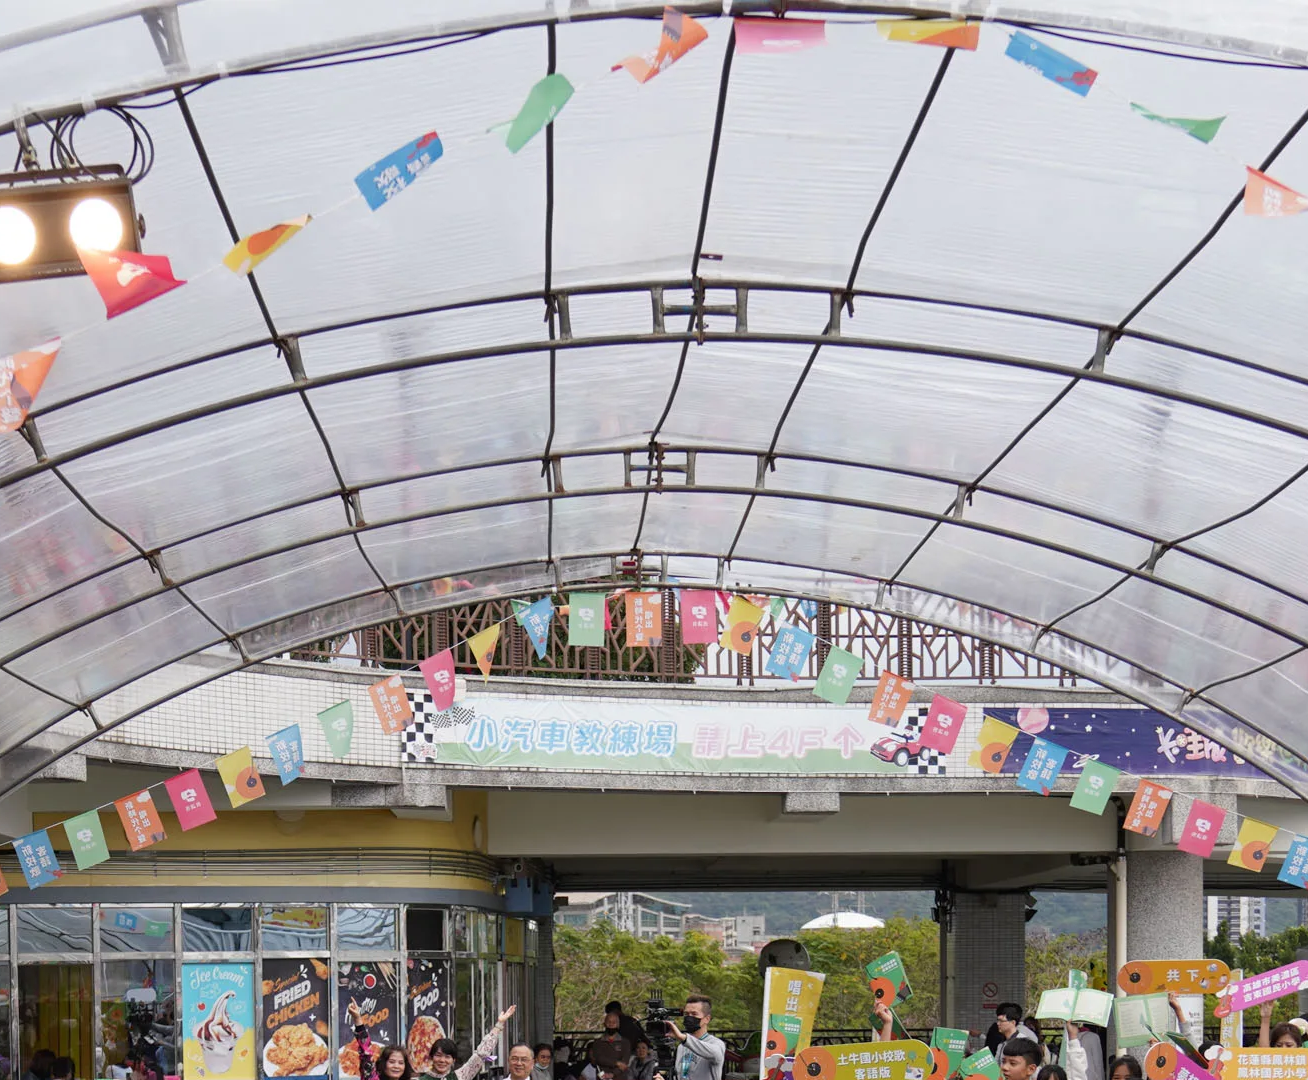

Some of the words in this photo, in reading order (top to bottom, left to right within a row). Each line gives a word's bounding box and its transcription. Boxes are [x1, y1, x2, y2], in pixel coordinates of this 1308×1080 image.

[466, 716, 678, 759] 小汽車教練場
[190, 968, 211, 989] Ice
[212, 966, 245, 988] Cream
[1166, 968, 1201, 984] 共下
[274, 980, 311, 1010] FRIED
[413, 988, 440, 1016] FOOD
[266, 992, 320, 1029] CHICKEN
[837, 1049, 906, 1067] 土牛國小校歌
[854, 1066, 892, 1080] 客語版
